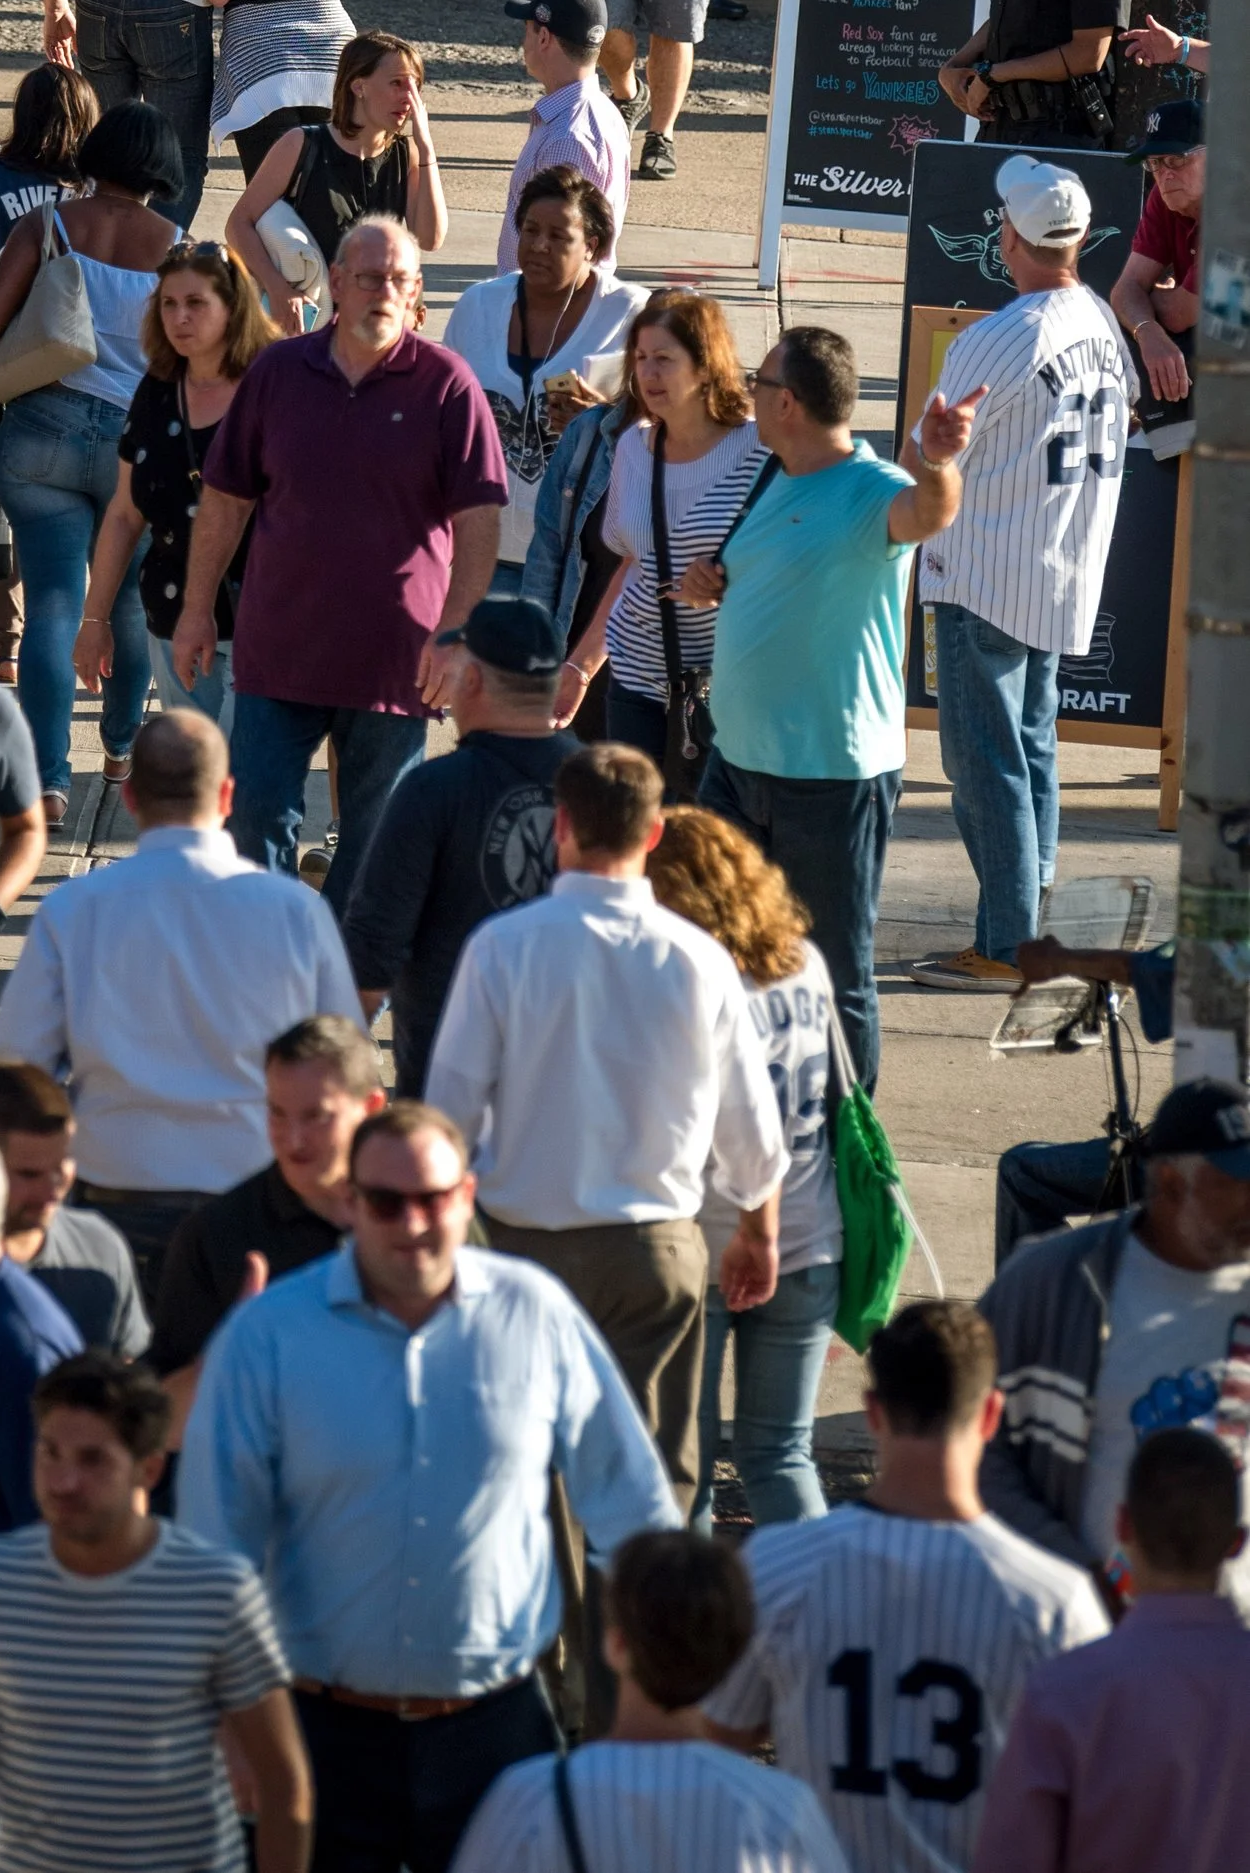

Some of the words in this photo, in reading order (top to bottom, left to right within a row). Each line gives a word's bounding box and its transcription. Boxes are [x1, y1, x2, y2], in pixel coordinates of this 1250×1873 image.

[842, 22, 863, 42] Red
[867, 25, 885, 42] Sox
[890, 24, 915, 42] fans
[920, 30, 939, 43] are
[838, 41, 876, 59] already
[880, 42, 915, 59] looking
[847, 56, 861, 66] to
[918, 57, 948, 69] seas
[816, 74, 841, 91] Lets
[845, 82, 857, 95] go
[862, 71, 941, 106] YANKEES
[1147, 112, 1161, 133] NY
[793, 173, 818, 187] THE
[820, 165, 906, 198] Silver
[1047, 386, 1127, 486] 23
[827, 1648, 983, 1806] 13
